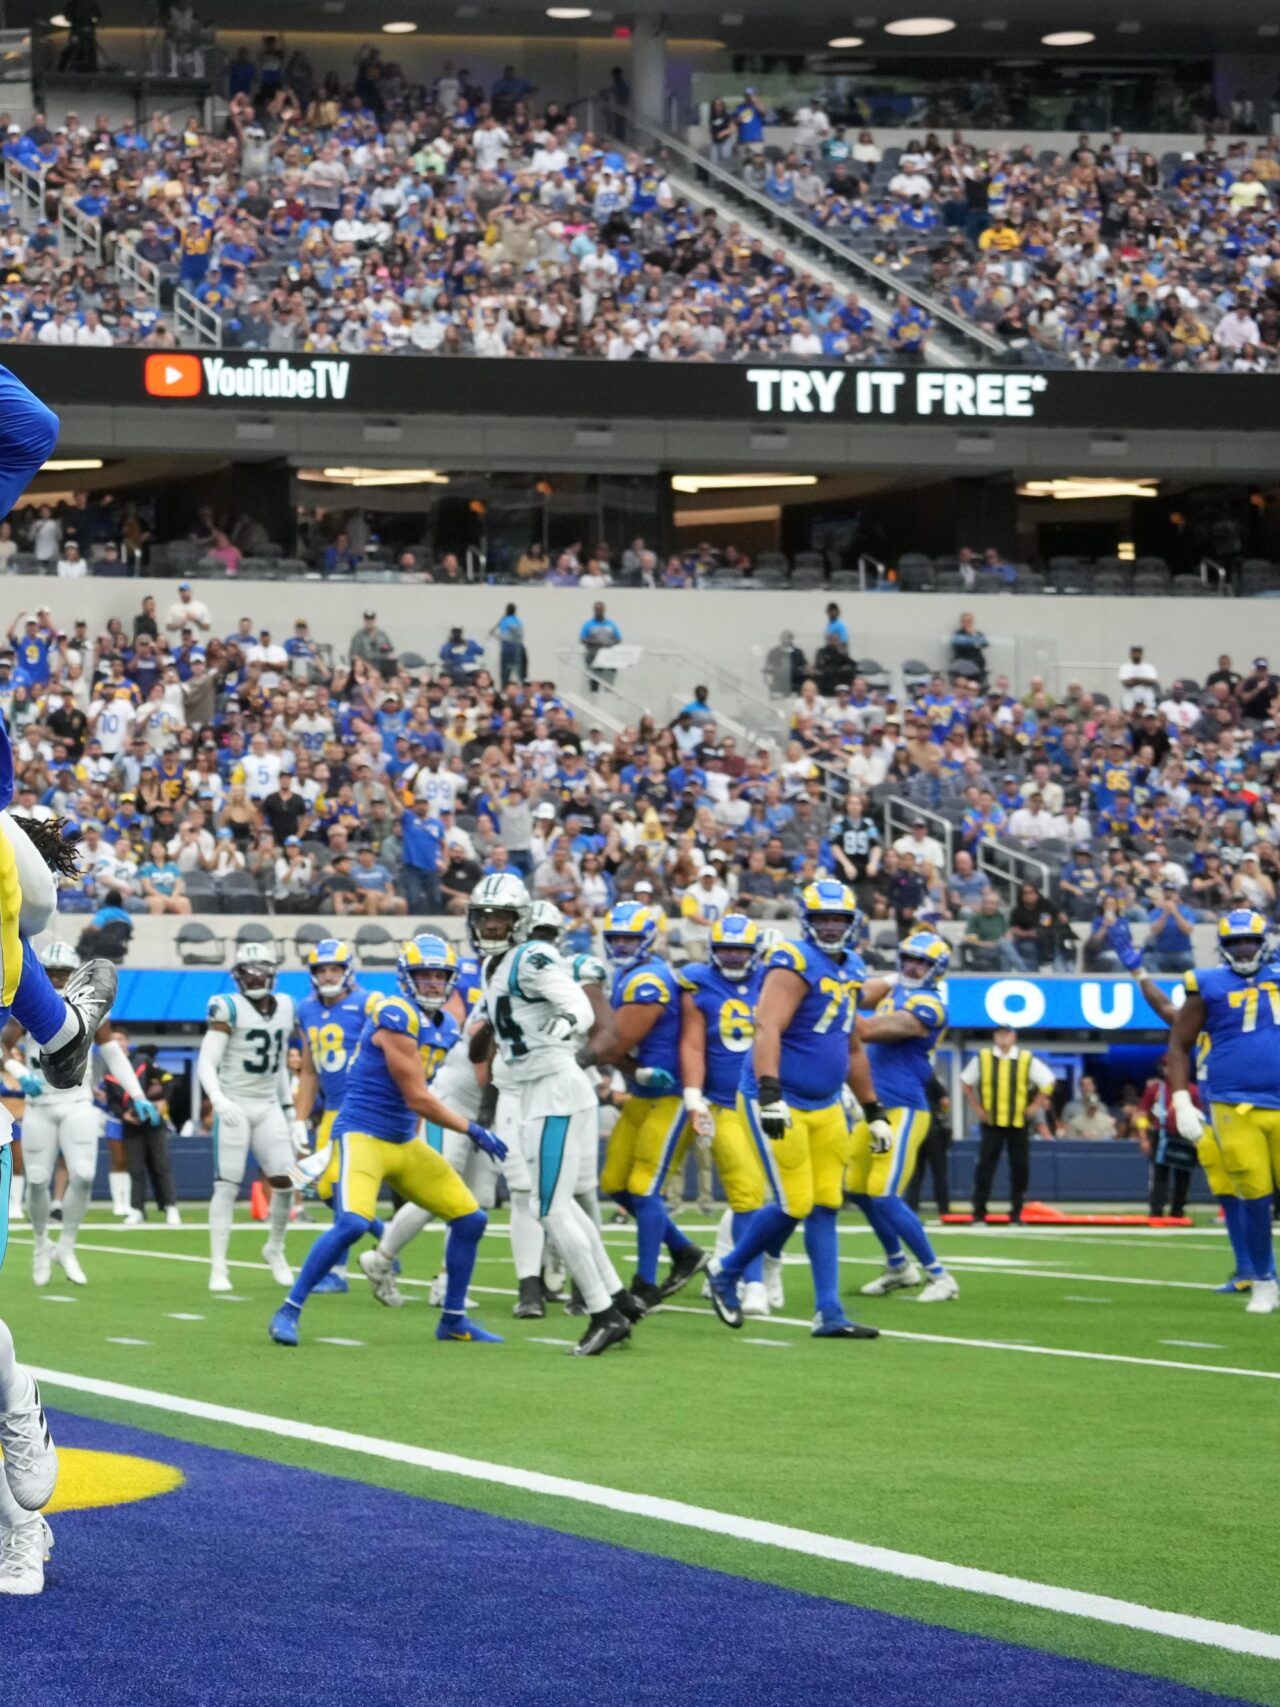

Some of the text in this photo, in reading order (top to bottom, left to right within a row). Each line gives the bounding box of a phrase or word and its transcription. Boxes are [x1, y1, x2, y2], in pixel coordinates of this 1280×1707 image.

[746, 369, 846, 413] TRY
[857, 371, 906, 414] IT
[425, 780, 452, 801] 99
[480, 994, 530, 1057] 4
[718, 998, 757, 1053] 6
[811, 976, 863, 1035] 77
[243, 1028, 284, 1074] 31
[308, 1022, 348, 1074] 18
